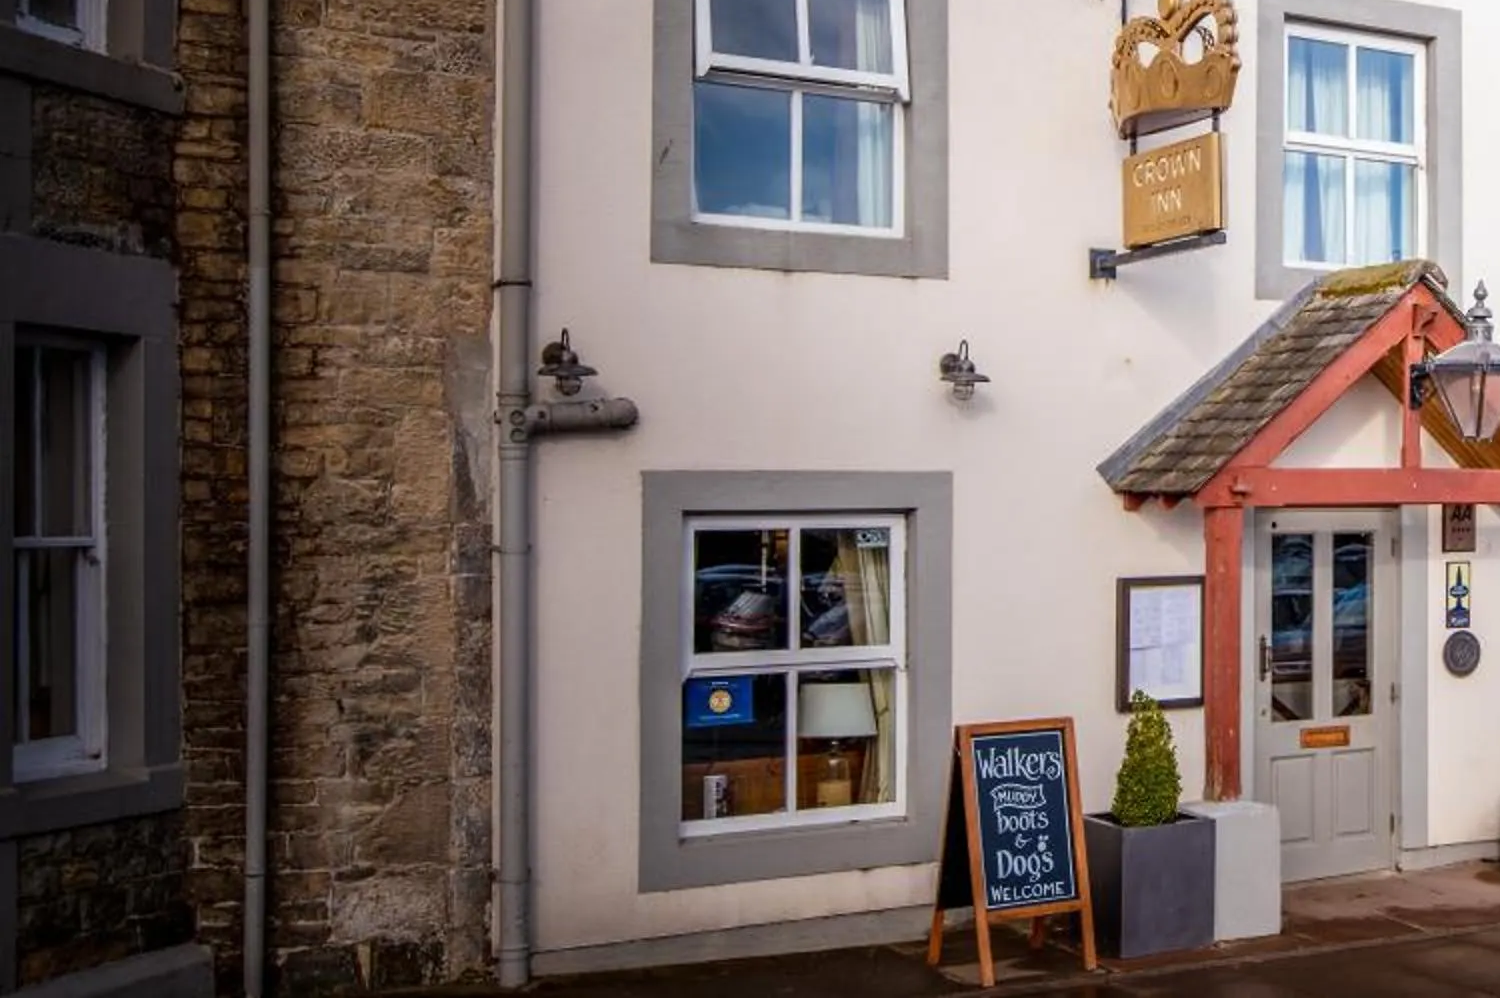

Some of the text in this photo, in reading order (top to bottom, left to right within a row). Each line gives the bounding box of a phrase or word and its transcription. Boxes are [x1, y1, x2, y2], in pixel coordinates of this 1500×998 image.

[1133, 146, 1202, 187] CROWN
[1152, 185, 1182, 213] INN
[976, 746, 1061, 781] Walkers
[997, 789, 1037, 804] MUDDY
[996, 809, 1050, 835] boots
[1014, 833, 1034, 849] &
[996, 849, 1055, 883] Dogs
[990, 881, 1066, 902] WELCOME
